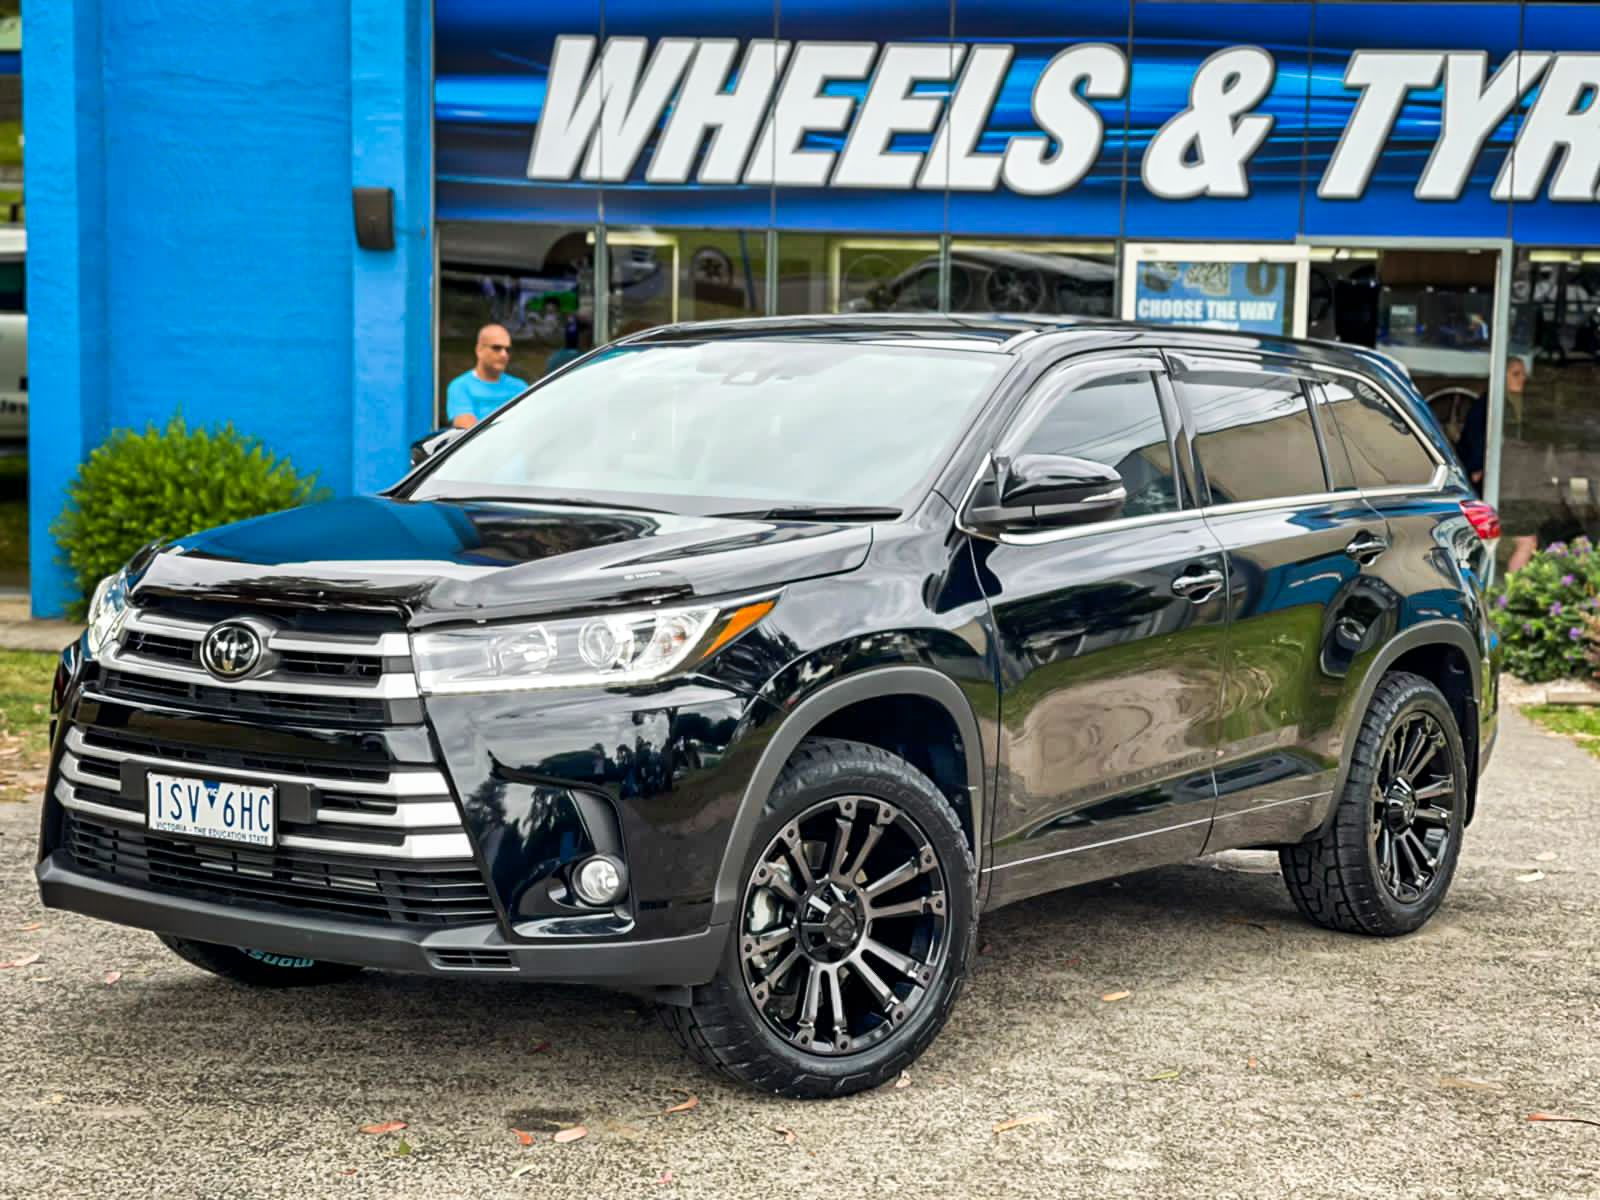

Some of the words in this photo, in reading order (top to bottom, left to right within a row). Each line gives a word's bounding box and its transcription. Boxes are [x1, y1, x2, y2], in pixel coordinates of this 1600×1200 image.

[527, 35, 1129, 195] WHEELS
[1141, 44, 1275, 198] &
[1317, 49, 1600, 201] TYR
[1137, 298, 1203, 319] CHOOSE
[1206, 300, 1237, 319] THE
[1239, 301, 1278, 321] WAY
[156, 781, 200, 823] 1SV
[223, 791, 271, 832] 6HC
[156, 822, 187, 832] VICTORIA
[194, 826, 207, 835] THE
[208, 828, 247, 840] EDUCATION
[248, 834, 268, 843] STATE
